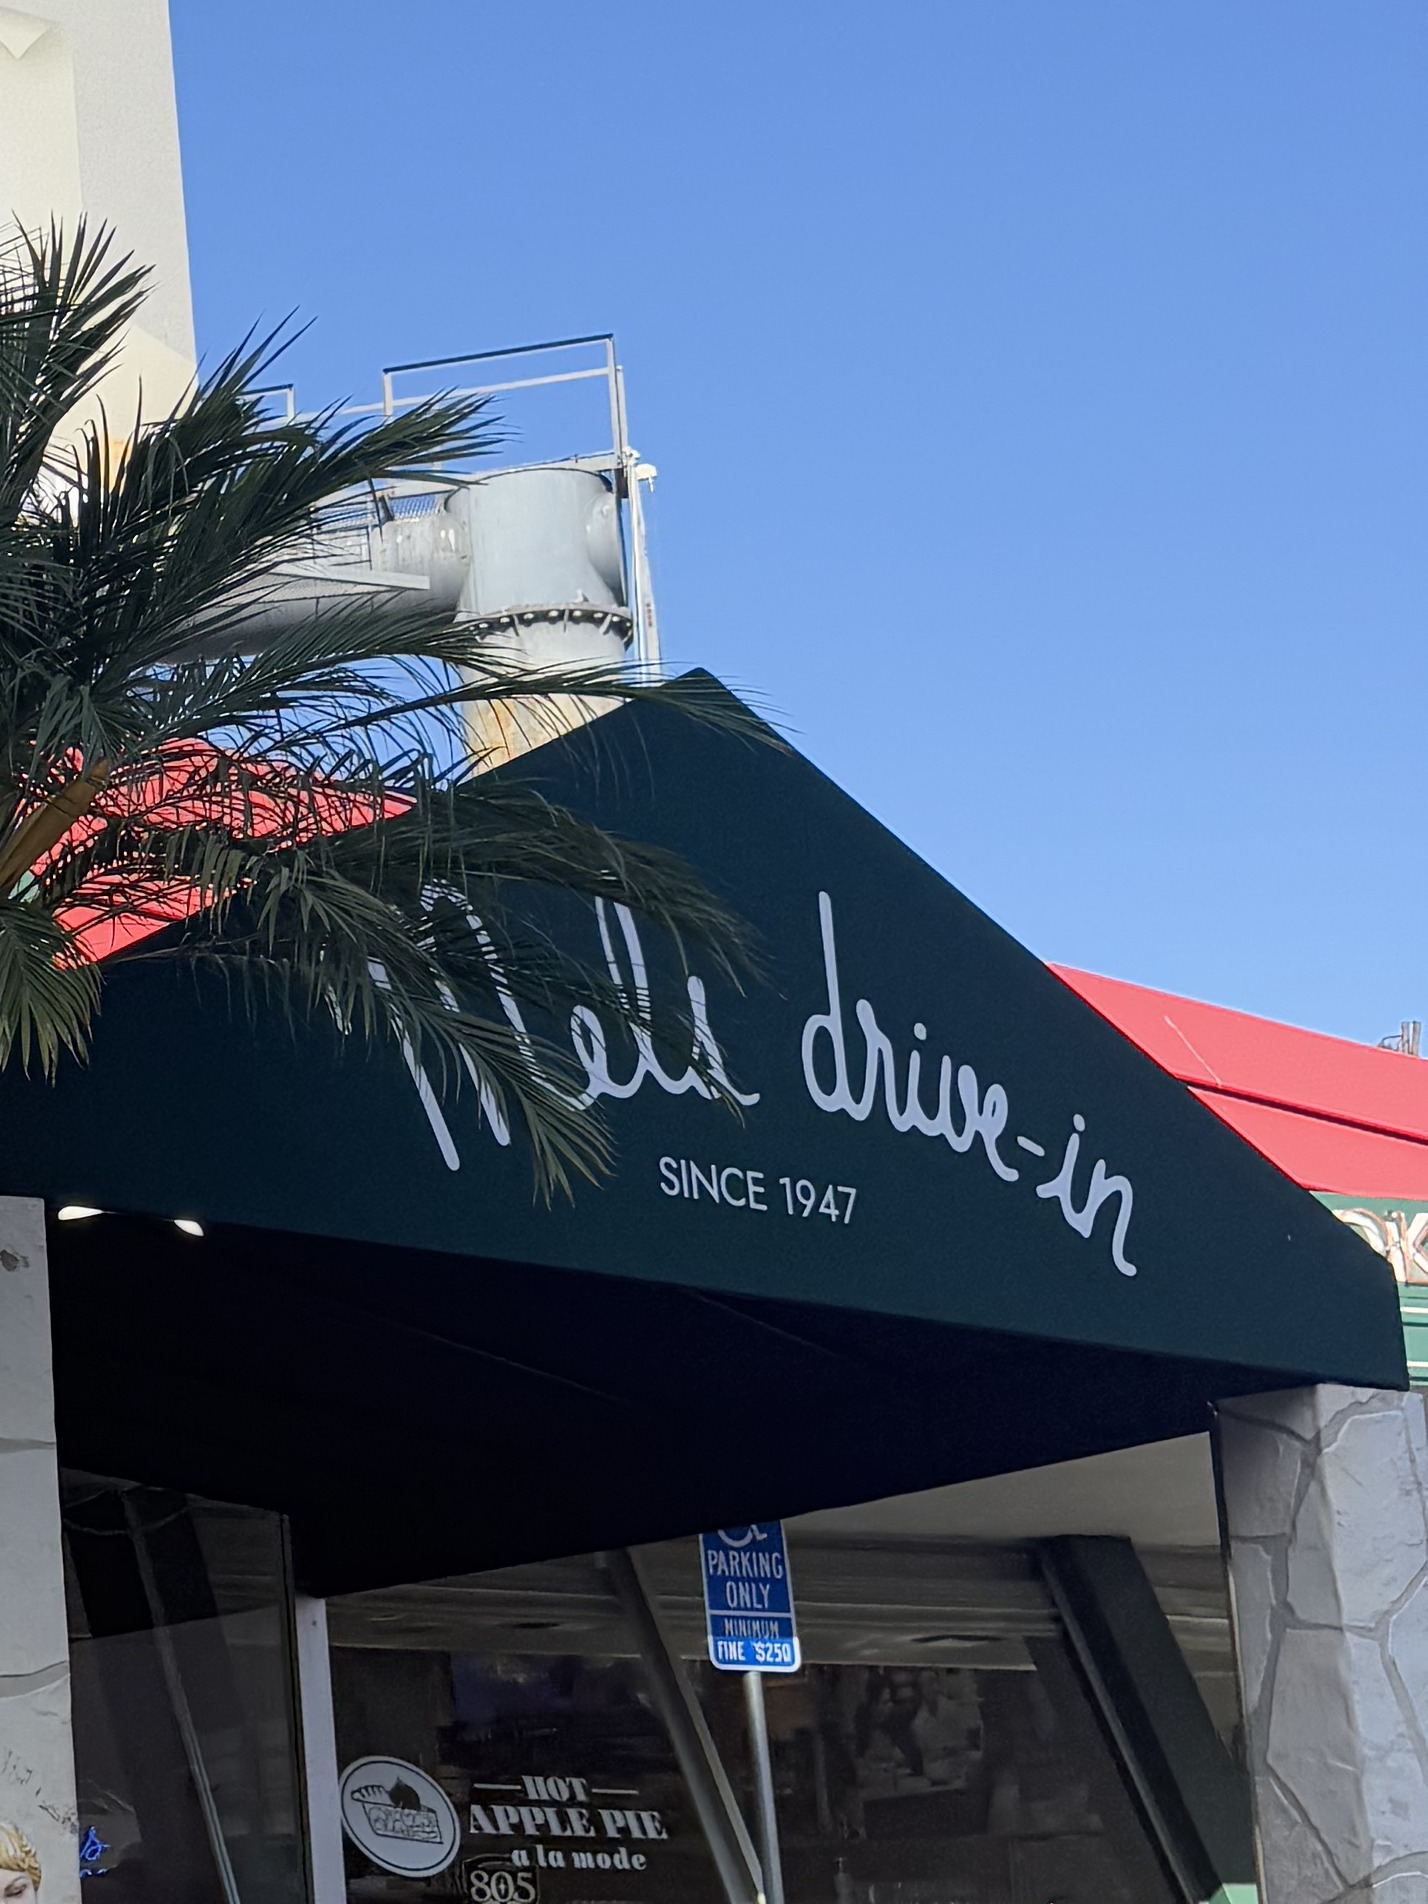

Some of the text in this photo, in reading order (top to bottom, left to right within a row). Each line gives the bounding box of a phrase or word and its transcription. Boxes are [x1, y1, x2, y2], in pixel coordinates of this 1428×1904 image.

[801, 891, 1138, 1277] drive-in
[658, 1156, 857, 1225] SINCE 1947
[707, 1550, 784, 1579] PARKING
[725, 1581, 771, 1609] ONLY
[724, 1618, 780, 1638] MINIMUM
[716, 1640, 792, 1663] FINE $250
[521, 1775, 589, 1802] HOT
[470, 1804, 669, 1840] APPLE PIE
[571, 1847, 648, 1871] mode
[470, 1870, 537, 1904] 805
